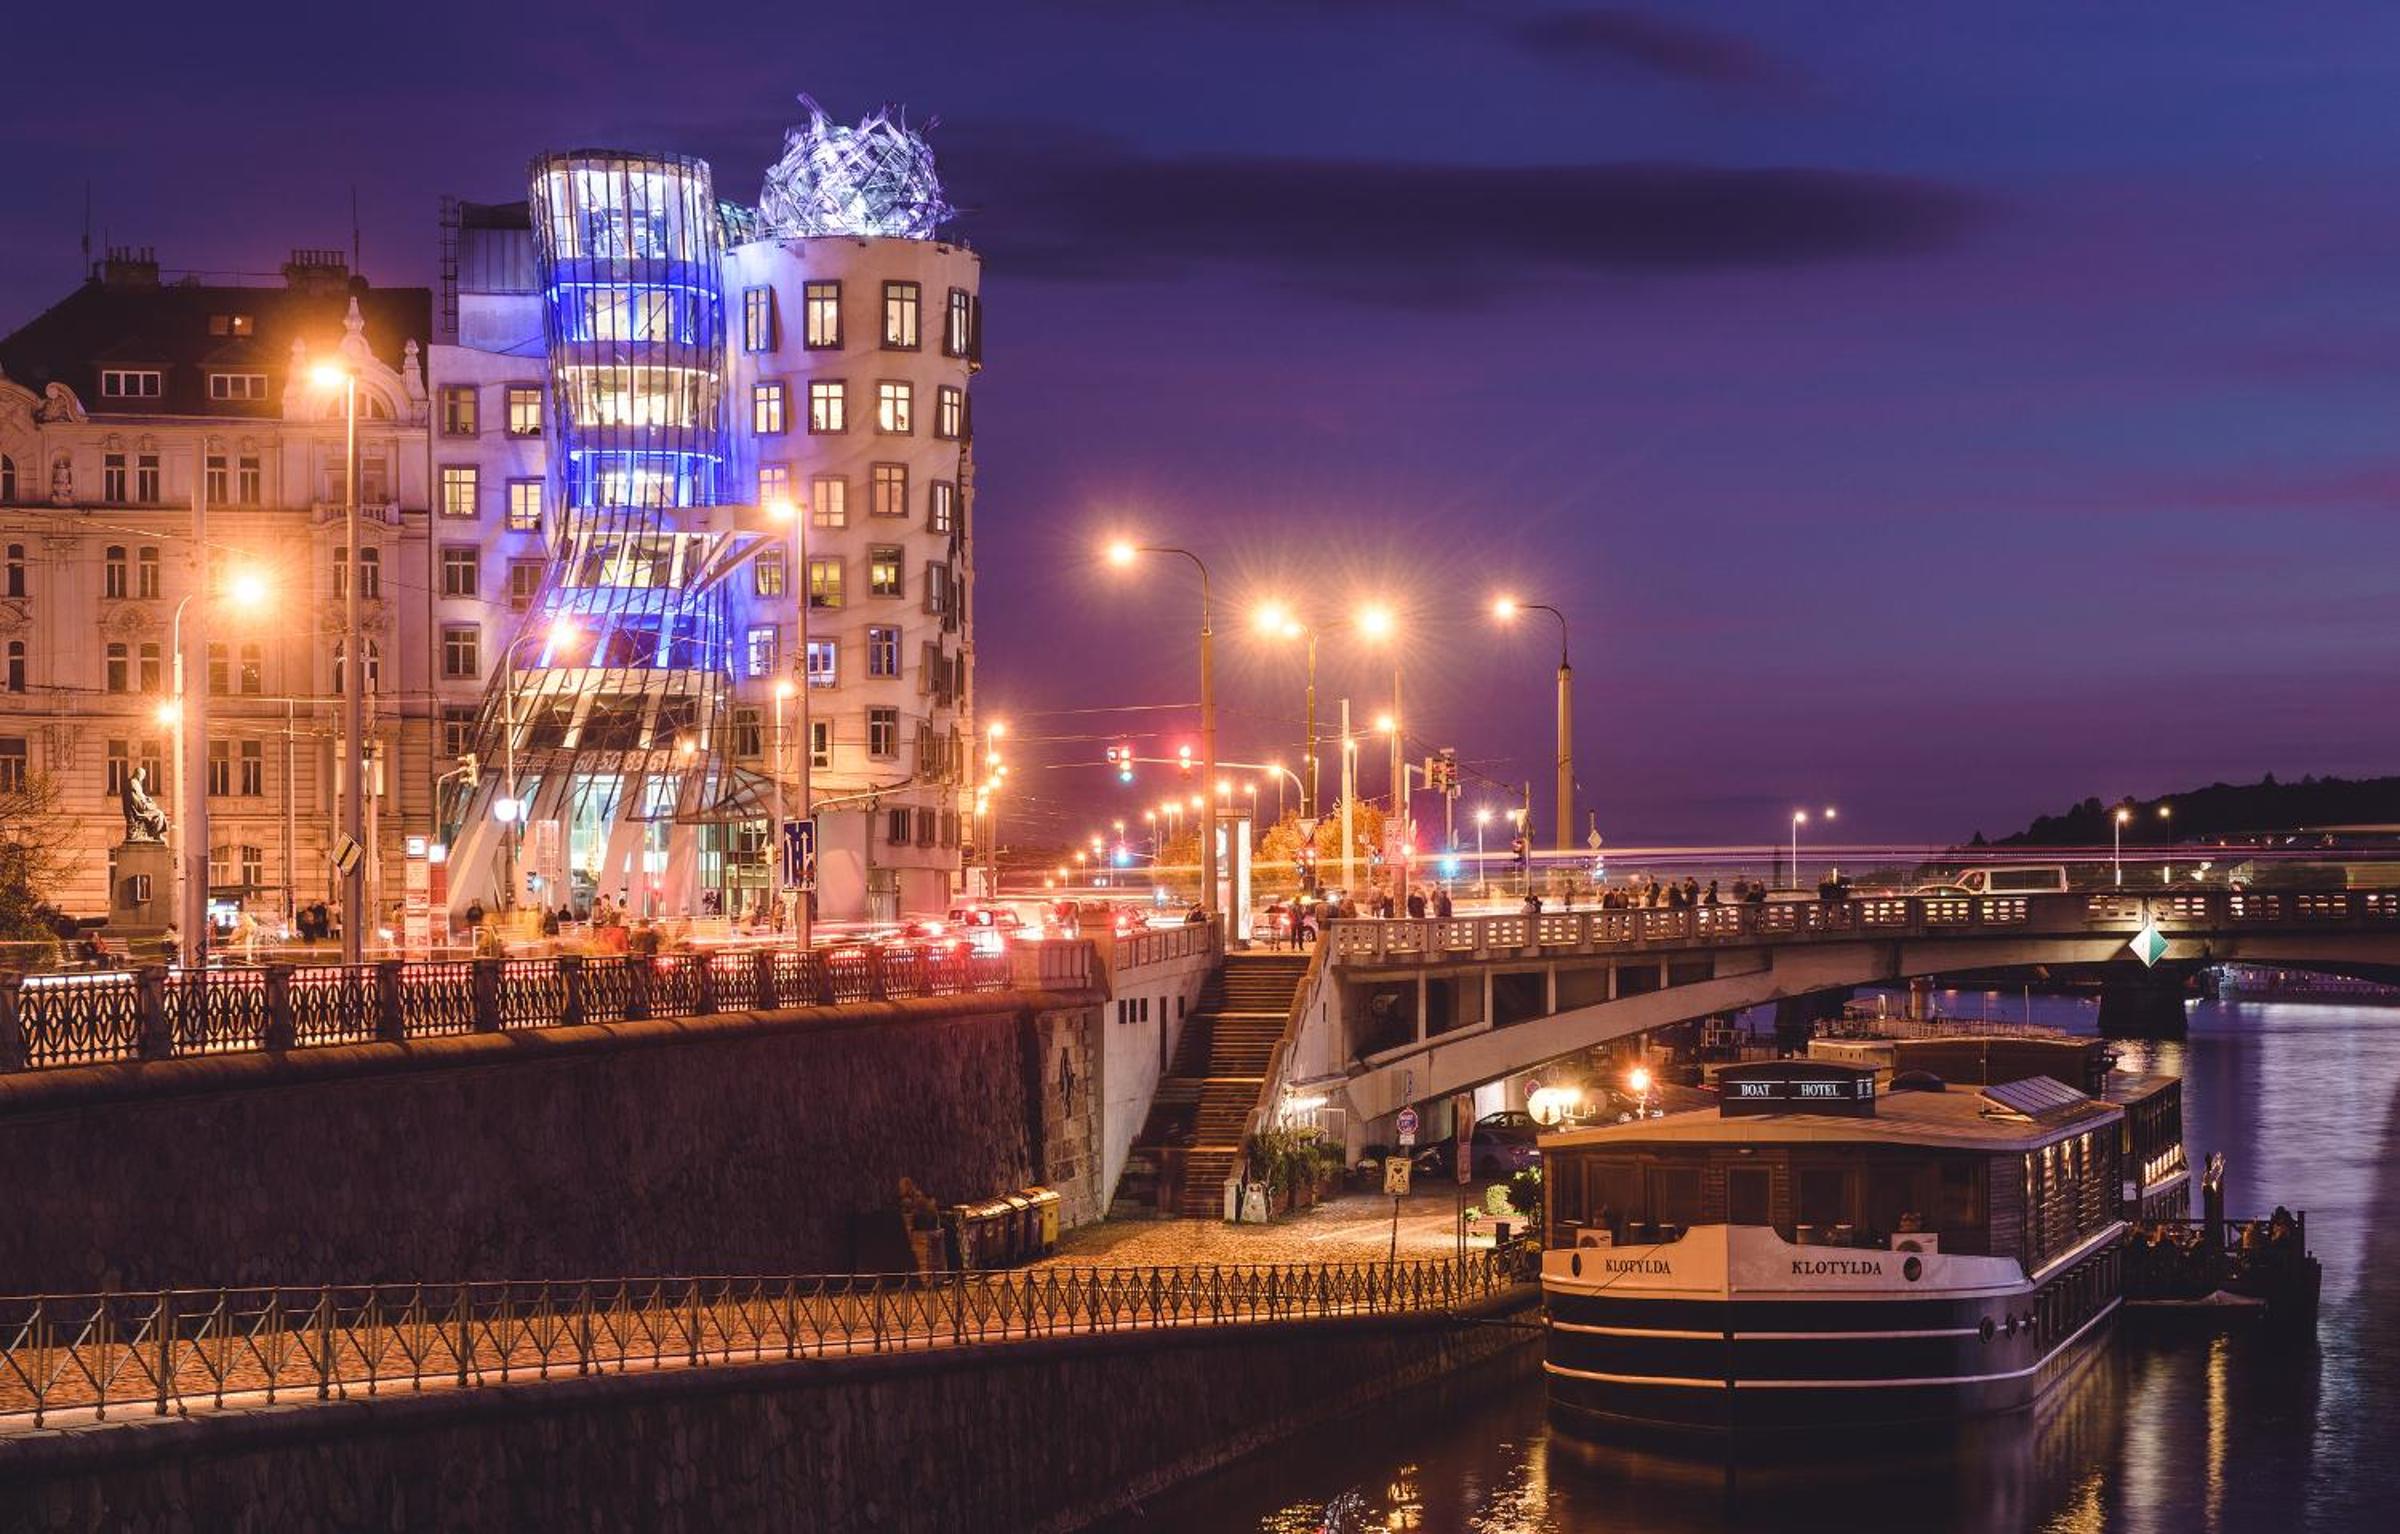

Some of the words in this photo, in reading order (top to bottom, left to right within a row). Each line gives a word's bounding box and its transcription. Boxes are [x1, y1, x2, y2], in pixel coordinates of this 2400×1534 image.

[1741, 1084, 1771, 1097] BOAT
[1801, 1084, 1840, 1097] HOTEL
[1791, 1261, 1882, 1275] KLOTYLDA
